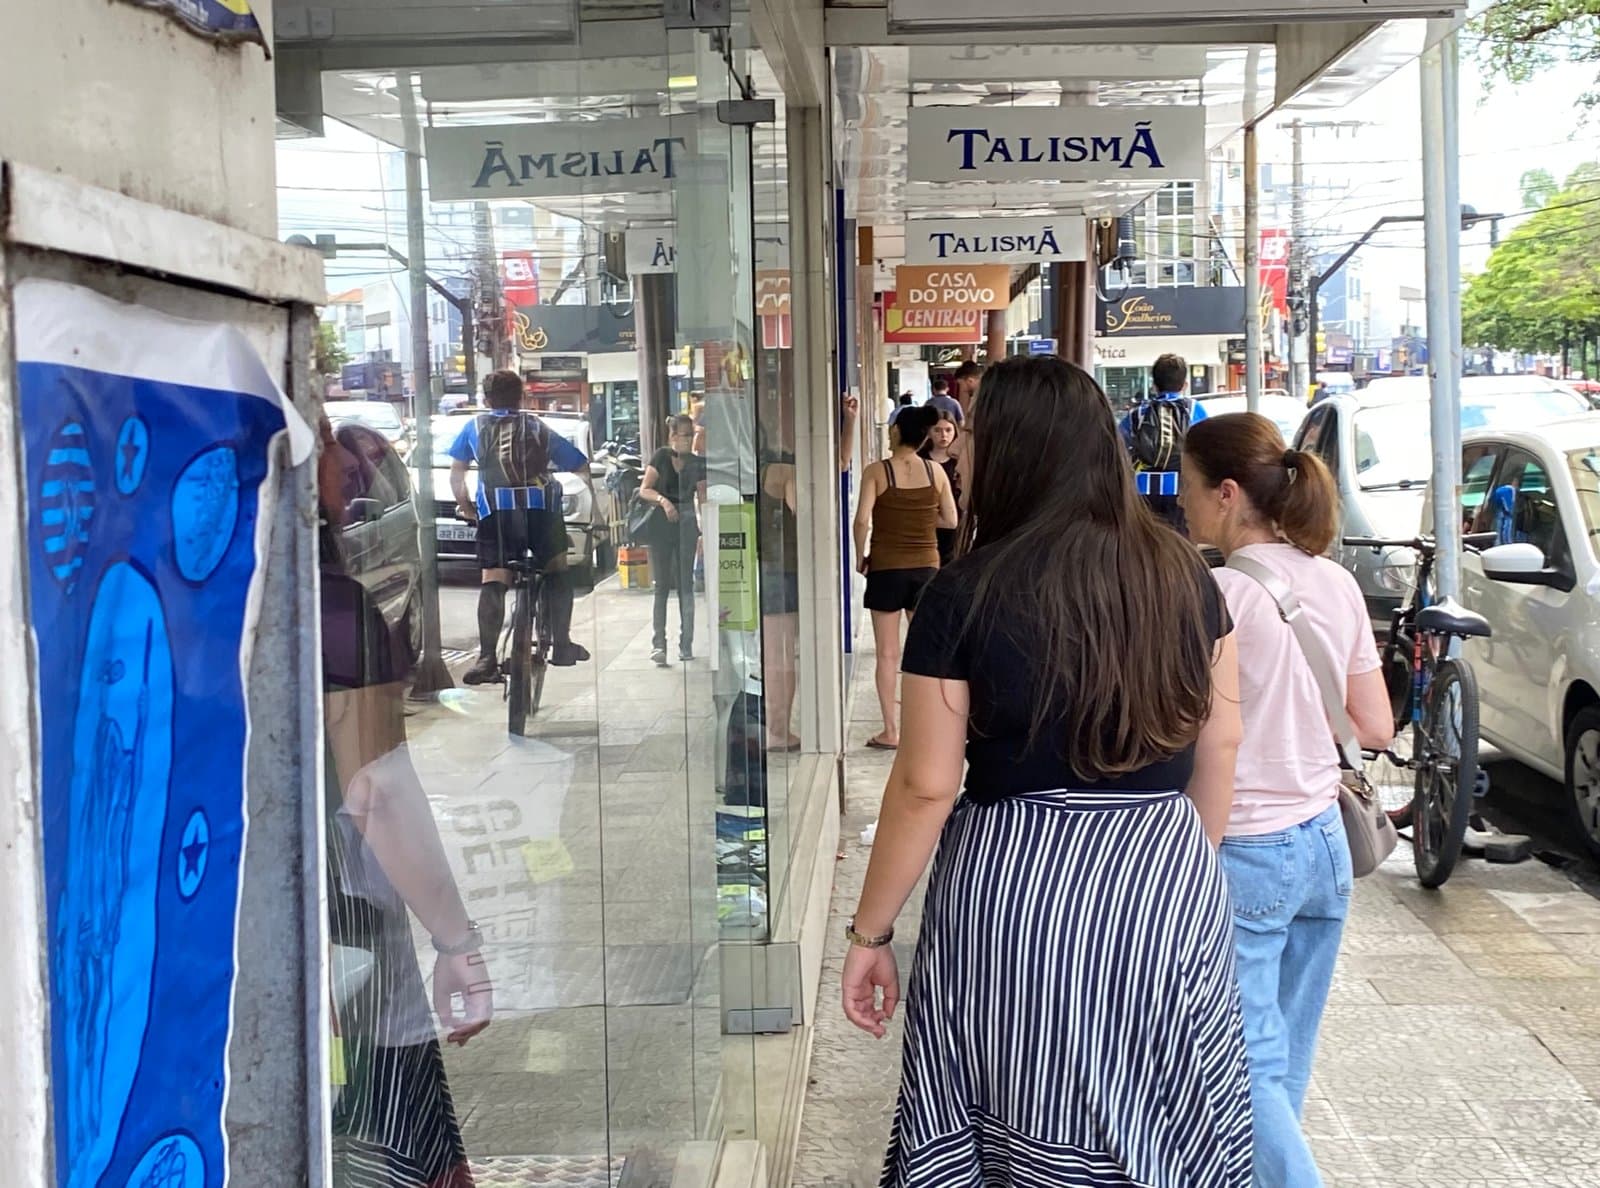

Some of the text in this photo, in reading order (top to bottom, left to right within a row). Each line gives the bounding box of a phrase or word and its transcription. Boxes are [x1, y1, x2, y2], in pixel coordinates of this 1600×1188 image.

[946, 120, 1165, 170] TALISMÃ
[930, 225, 1062, 258] TALISMÃ
[927, 272, 977, 288] CASA
[909, 288, 995, 304] DO POVO
